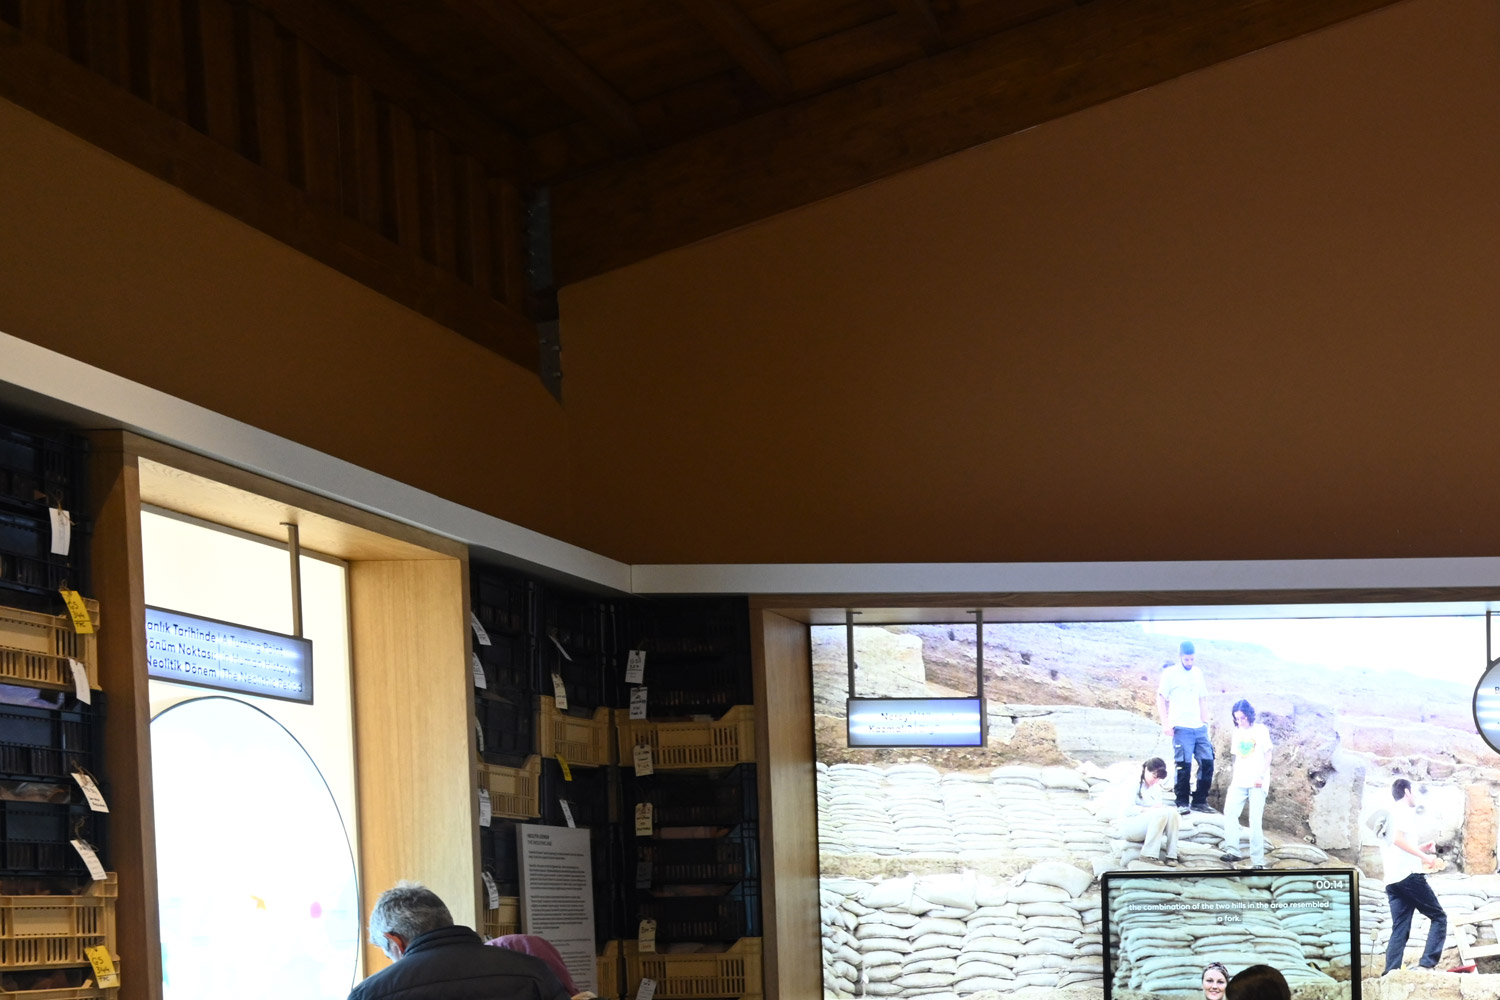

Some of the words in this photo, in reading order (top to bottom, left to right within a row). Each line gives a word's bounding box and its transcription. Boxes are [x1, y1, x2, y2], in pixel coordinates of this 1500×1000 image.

[146, 621, 170, 634] anlık
[173, 624, 216, 642] Tarihinde
[146, 638, 176, 652] önüm
[178, 642, 216, 660] Noktası:
[184, 662, 216, 677] Dönem
[1316, 880, 1344, 889] 00:14
